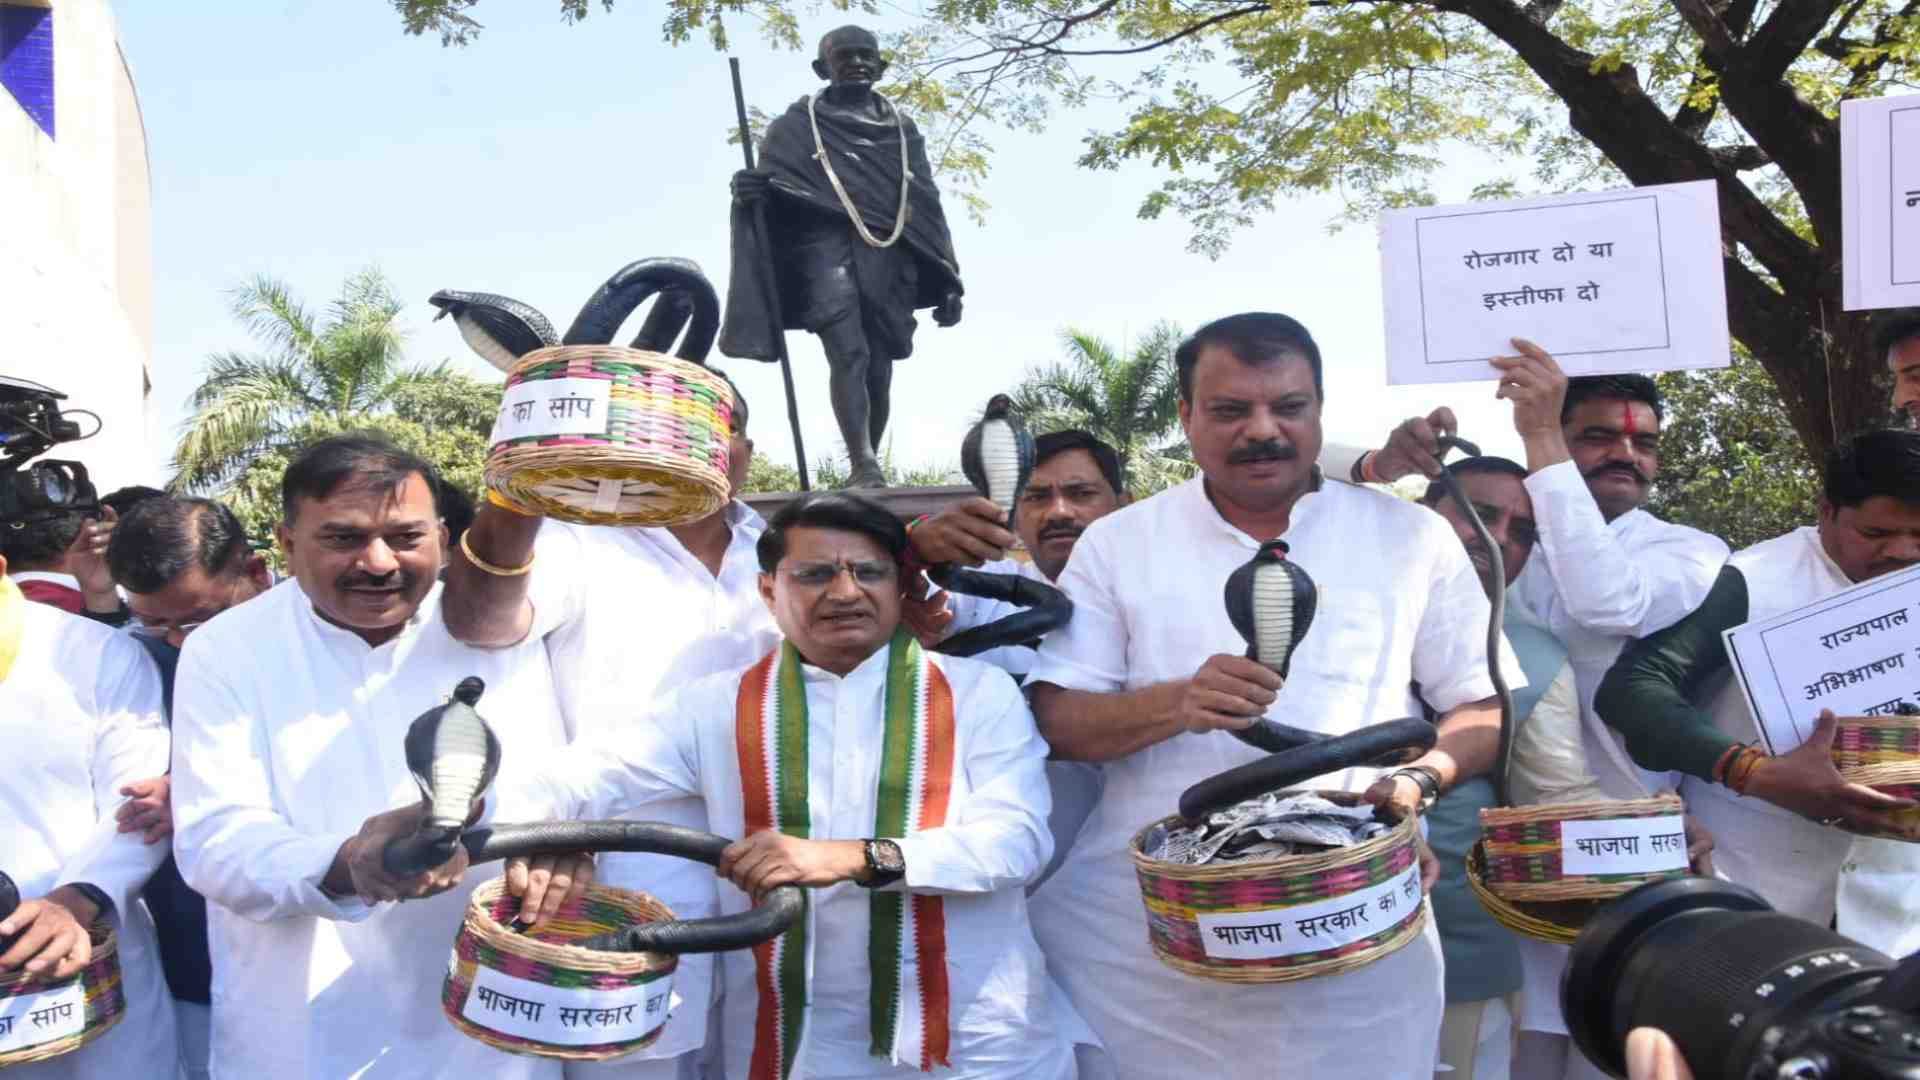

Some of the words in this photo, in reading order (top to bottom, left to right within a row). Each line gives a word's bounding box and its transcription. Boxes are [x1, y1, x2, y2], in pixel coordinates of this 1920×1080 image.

[1463, 249, 1541, 270] रोजगार
[1552, 241, 1576, 263] दो
[1588, 242, 1614, 258] या
[1482, 284, 1565, 311] इस्तीफा
[1576, 280, 1601, 302] दो
[512, 399, 536, 422] का
[549, 391, 596, 420] सांप
[1819, 607, 1909, 650] राज्यपाल
[1803, 653, 1905, 701] अभिभाषण
[1575, 836, 1640, 857] भाजपा
[1212, 922, 1282, 946] भाजपा
[1295, 902, 1370, 939] सरकार
[1377, 889, 1398, 913] का
[29, 1001, 75, 1029] सांप
[478, 985, 545, 1023] भाजपा
[559, 1003, 638, 1028] सरकार
